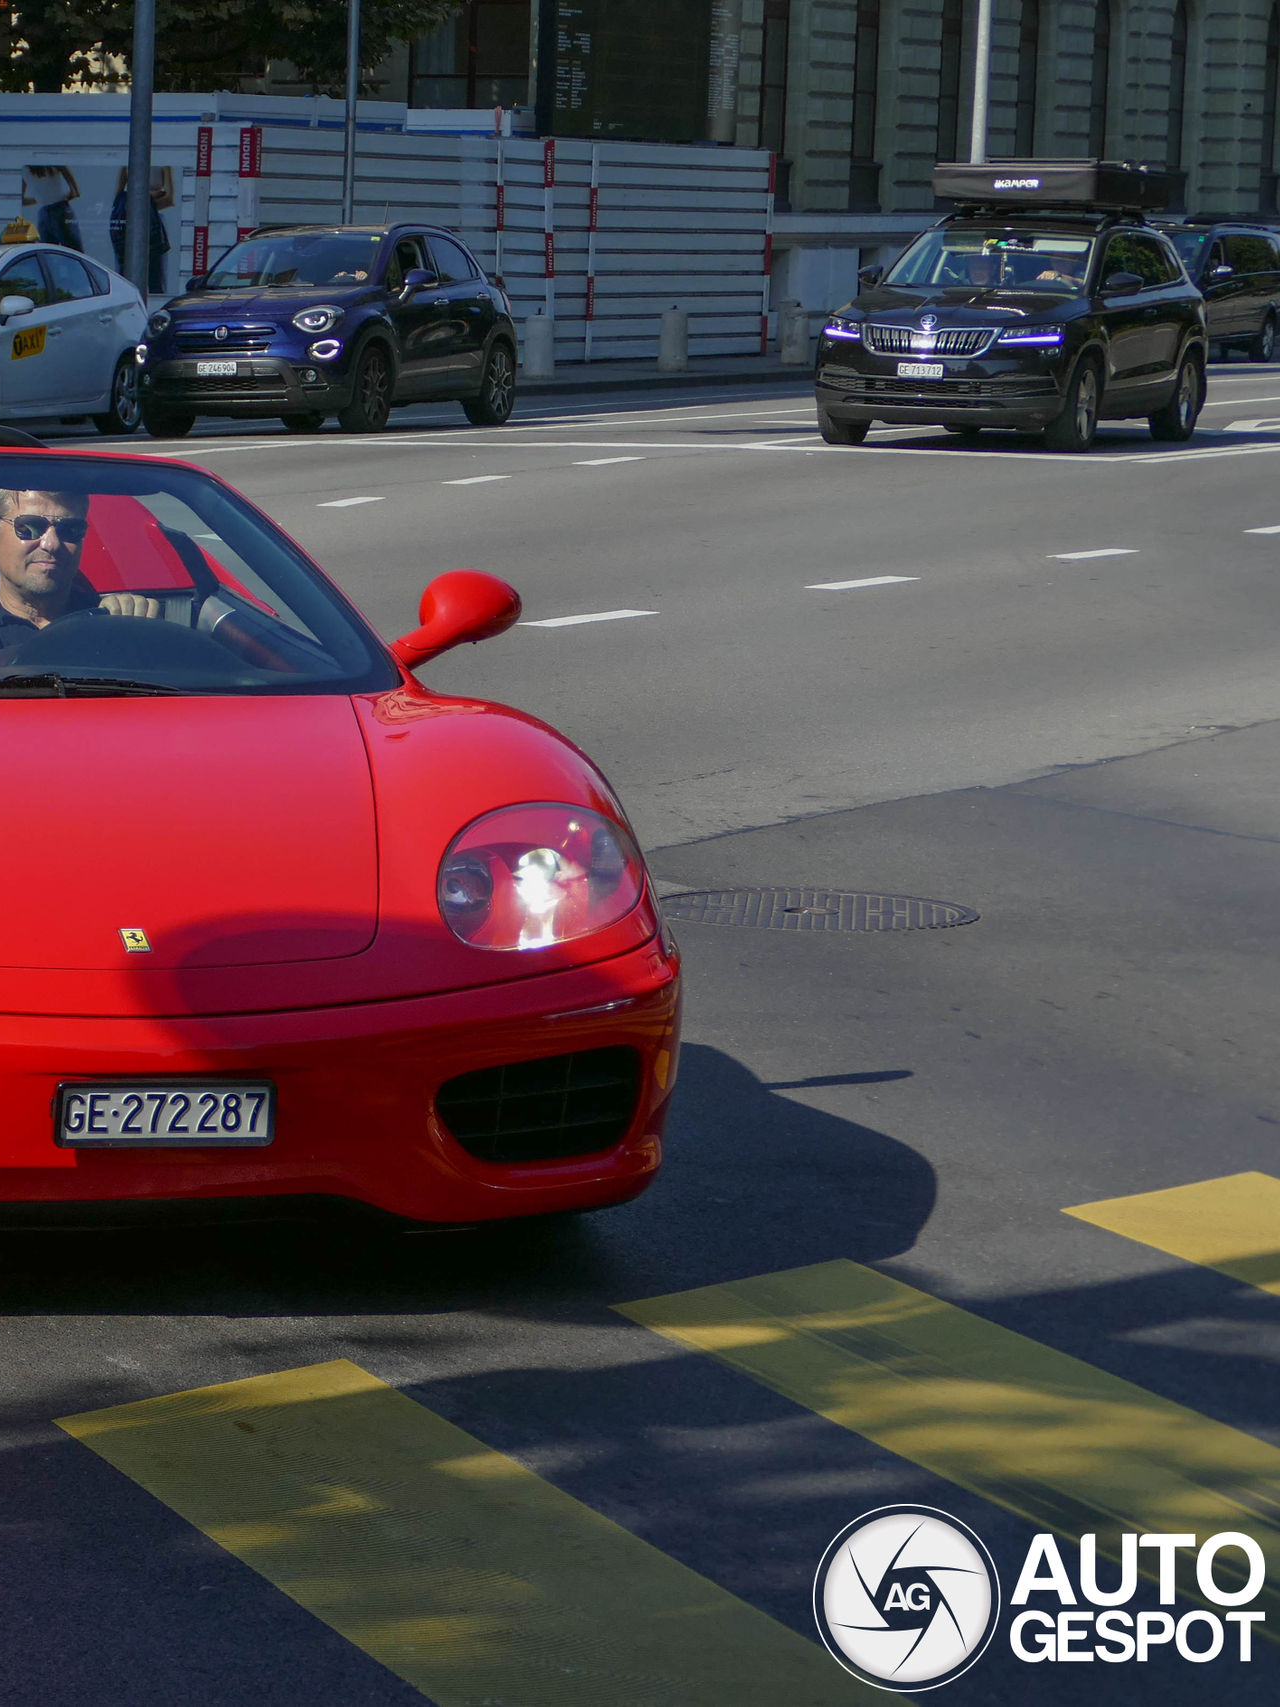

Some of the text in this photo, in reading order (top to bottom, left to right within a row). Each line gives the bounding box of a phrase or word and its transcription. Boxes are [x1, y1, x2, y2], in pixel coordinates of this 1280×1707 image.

[199, 132, 209, 171] INDUNI
[242, 133, 251, 172] INDUNI
[195, 231, 205, 271] INDUNI
[13, 327, 40, 355] TAXI
[911, 365, 942, 376] 713712
